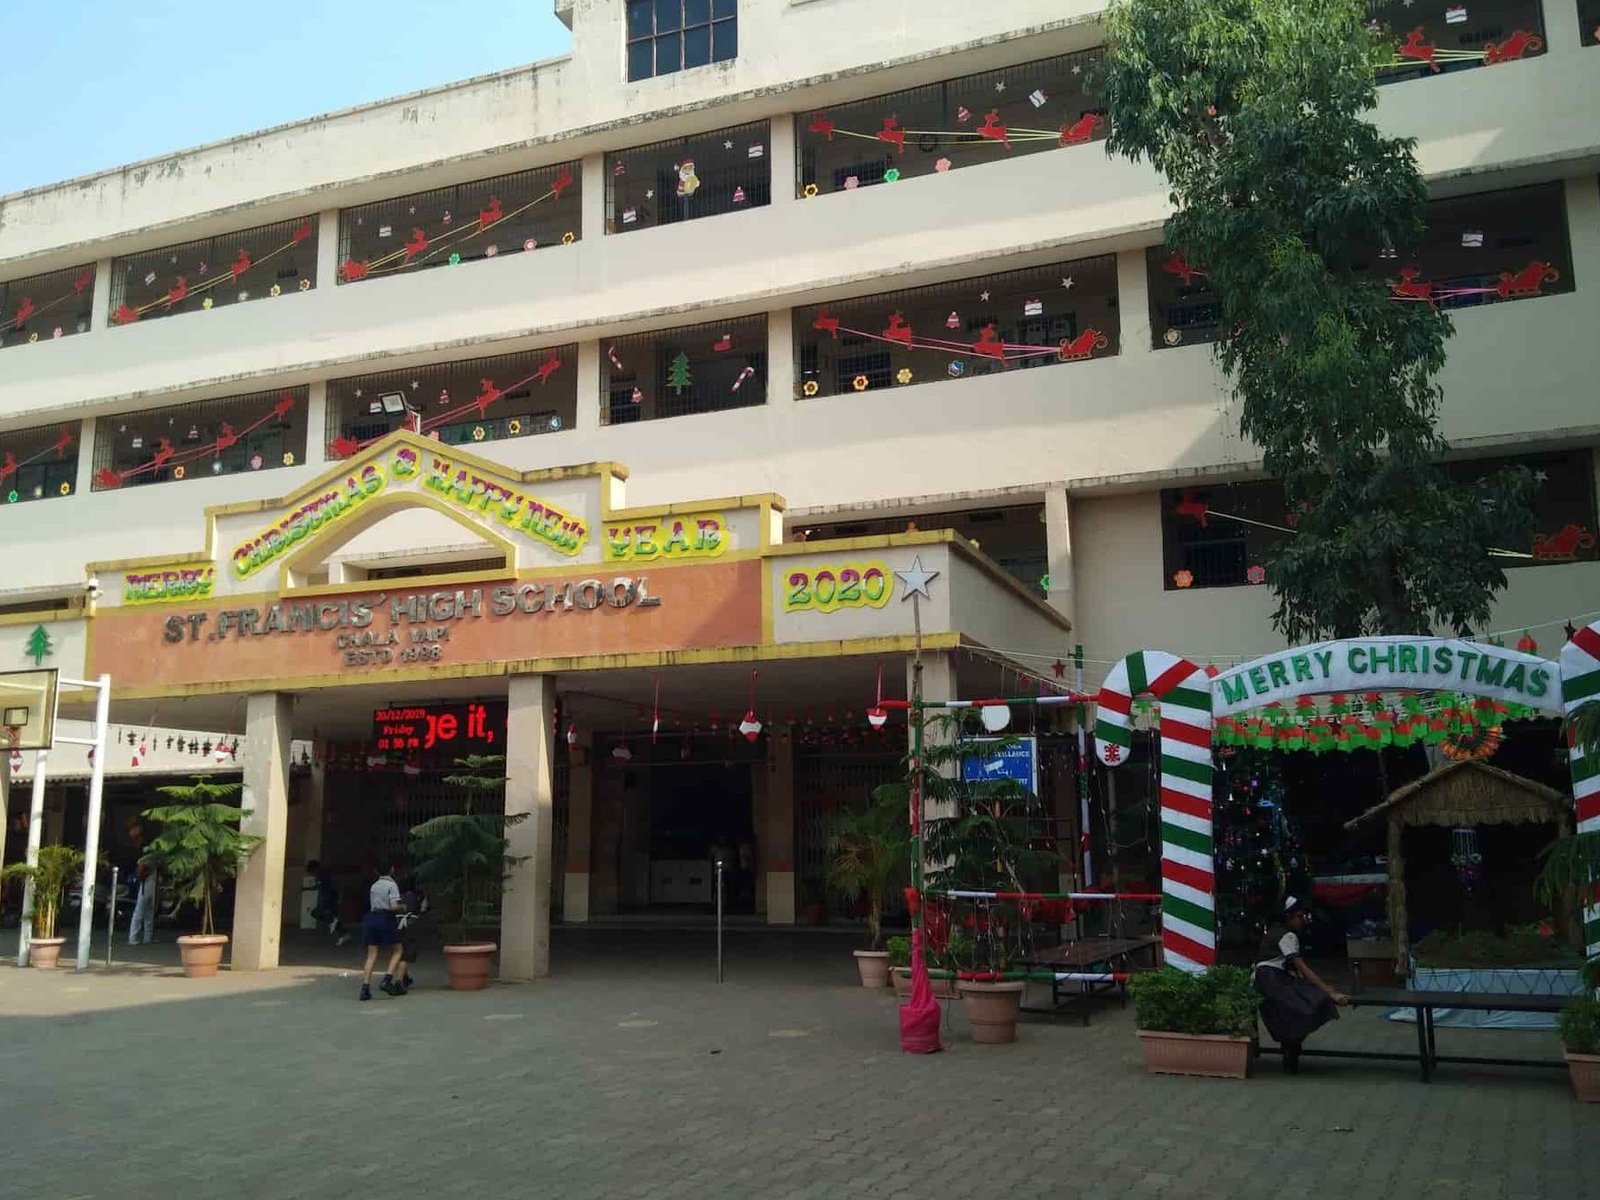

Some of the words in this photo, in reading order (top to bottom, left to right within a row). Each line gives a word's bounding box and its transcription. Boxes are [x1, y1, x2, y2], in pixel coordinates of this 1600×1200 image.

[232, 465, 382, 575] CHRISTMAS
[426, 459, 523, 520] HAPPY
[522, 500, 585, 549] NEW
[608, 519, 722, 557] YEAR
[788, 567, 884, 606] 2020
[391, 588, 483, 624] HIGH
[492, 576, 661, 616] SCHOOL
[1219, 651, 1332, 705] MERRY
[1348, 645, 1550, 697] CHRISTMAS
[383, 724, 415, 736] Friday
[467, 702, 494, 743] it,
